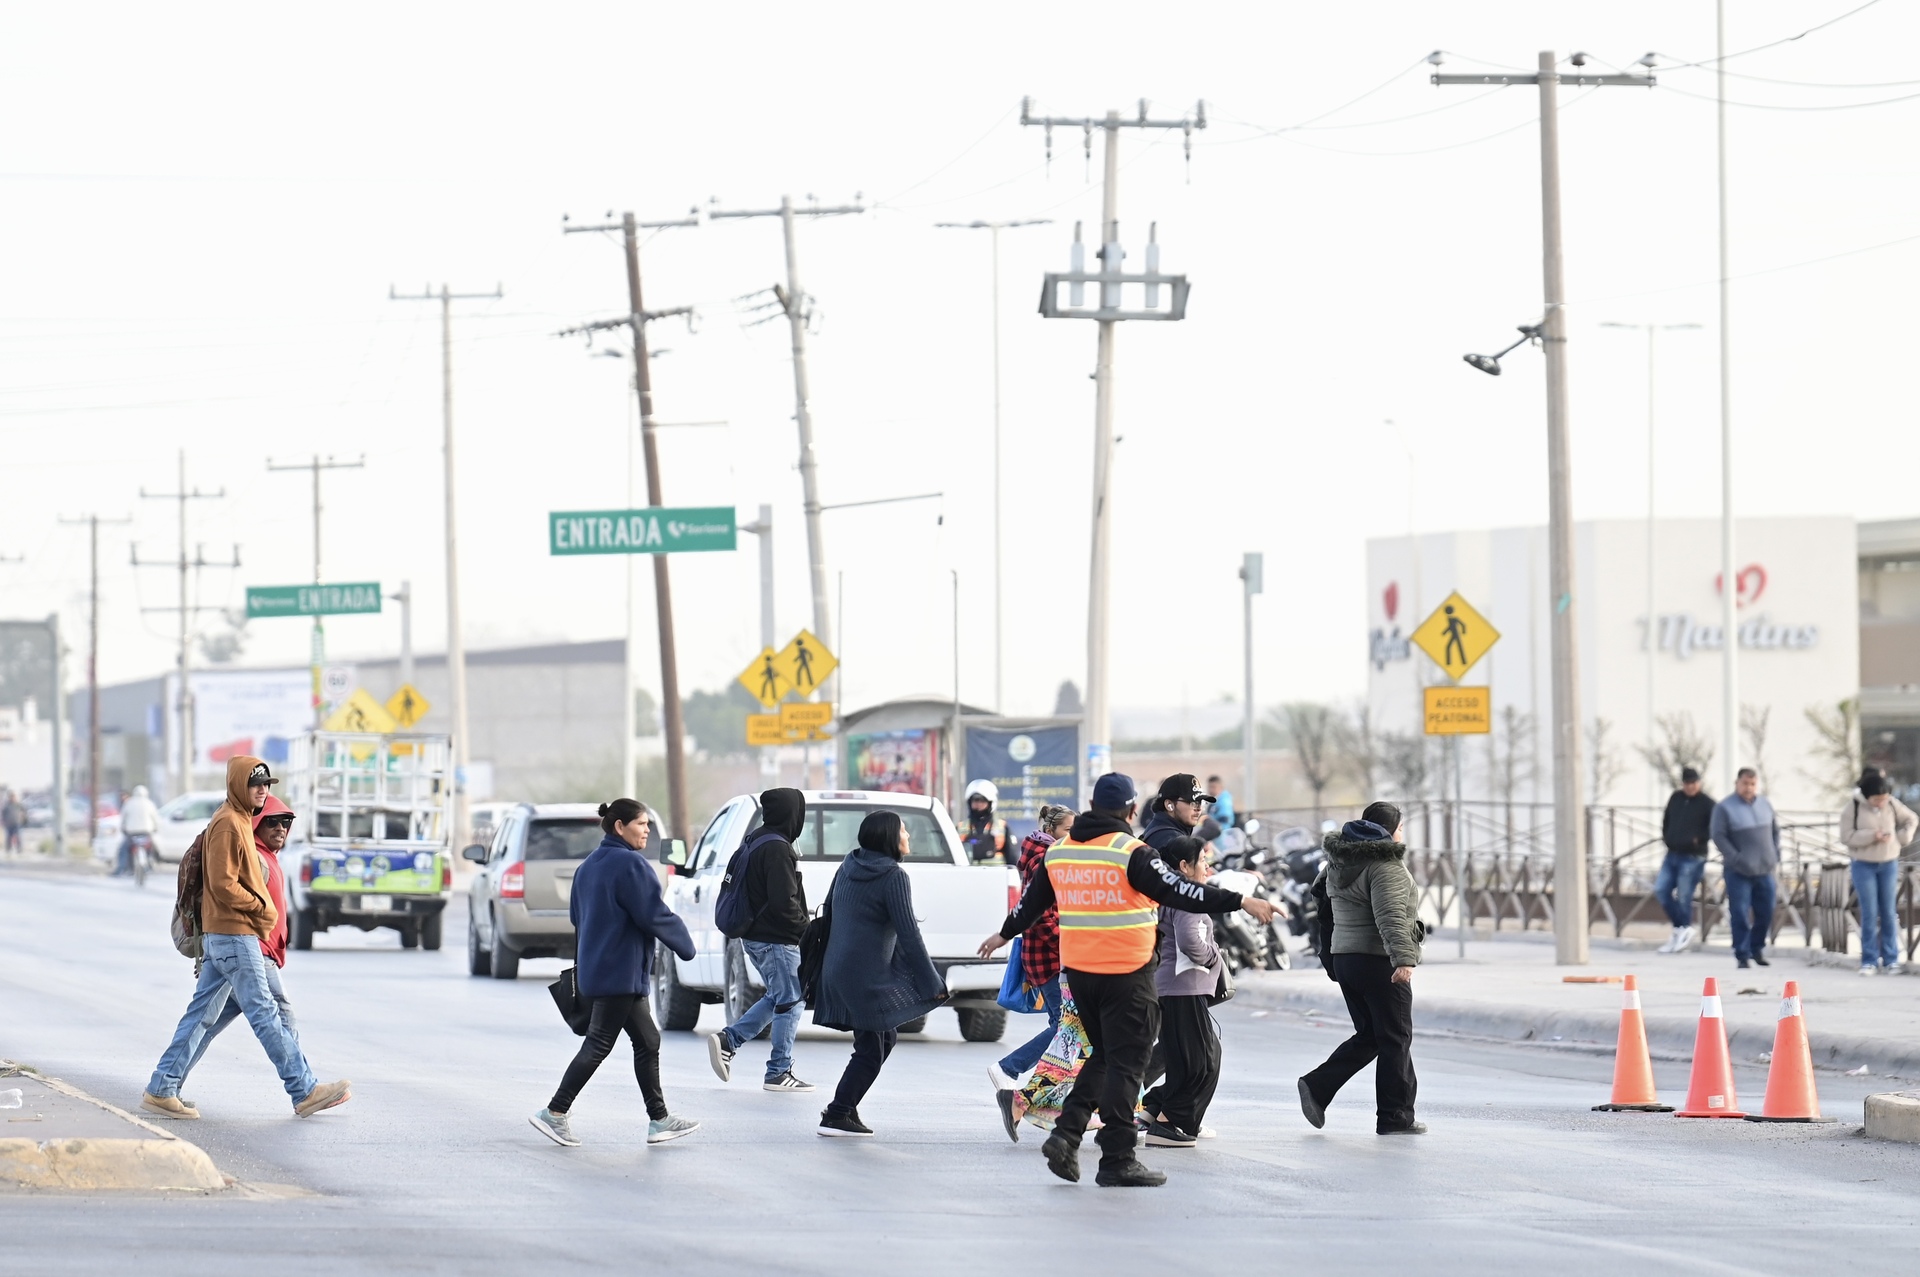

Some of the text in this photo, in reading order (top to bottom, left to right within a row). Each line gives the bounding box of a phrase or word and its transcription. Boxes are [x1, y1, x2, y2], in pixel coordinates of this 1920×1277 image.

[555, 516, 662, 548] ENTRADA
[298, 586, 378, 612] ENTRADA
[1436, 697, 1479, 708] ACCESO
[1428, 712, 1485, 723] PEATONAL
[1052, 865, 1120, 885] TRÁNSITO
